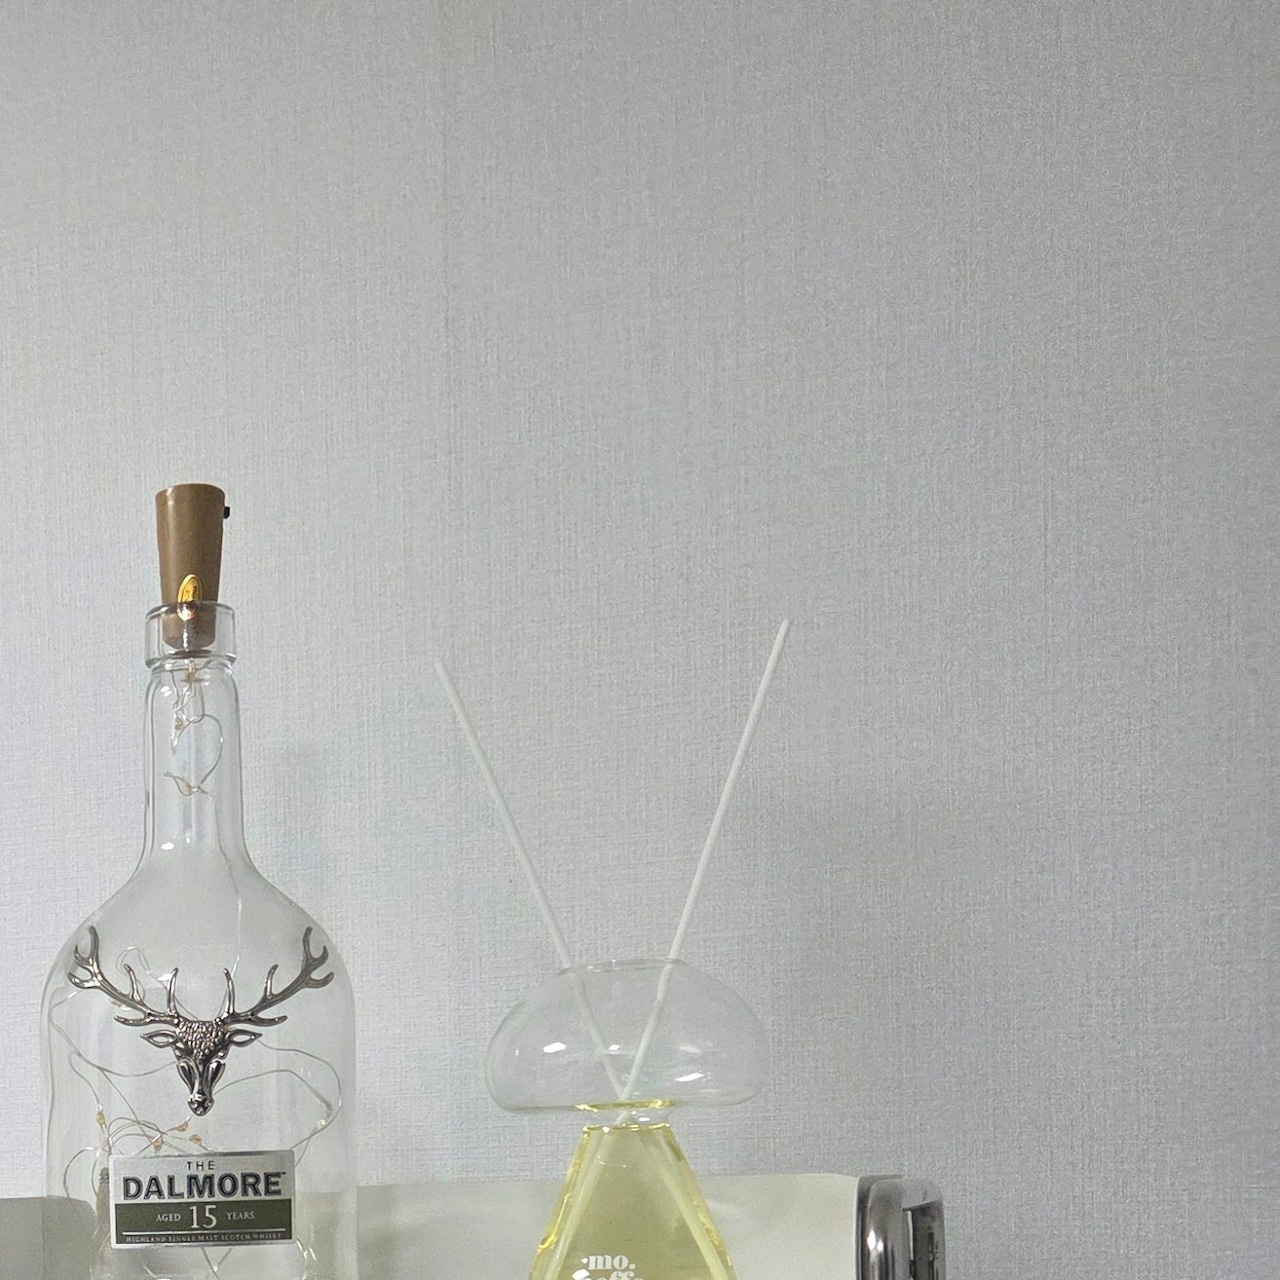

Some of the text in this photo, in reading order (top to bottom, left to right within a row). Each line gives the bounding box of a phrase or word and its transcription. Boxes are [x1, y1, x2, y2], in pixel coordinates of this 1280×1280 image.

[187, 1161, 216, 1171] THE
[122, 1172, 283, 1200] DALMORE
[155, 1205, 256, 1229] AGED 15 YEARS
[588, 1255, 636, 1270] mo.
